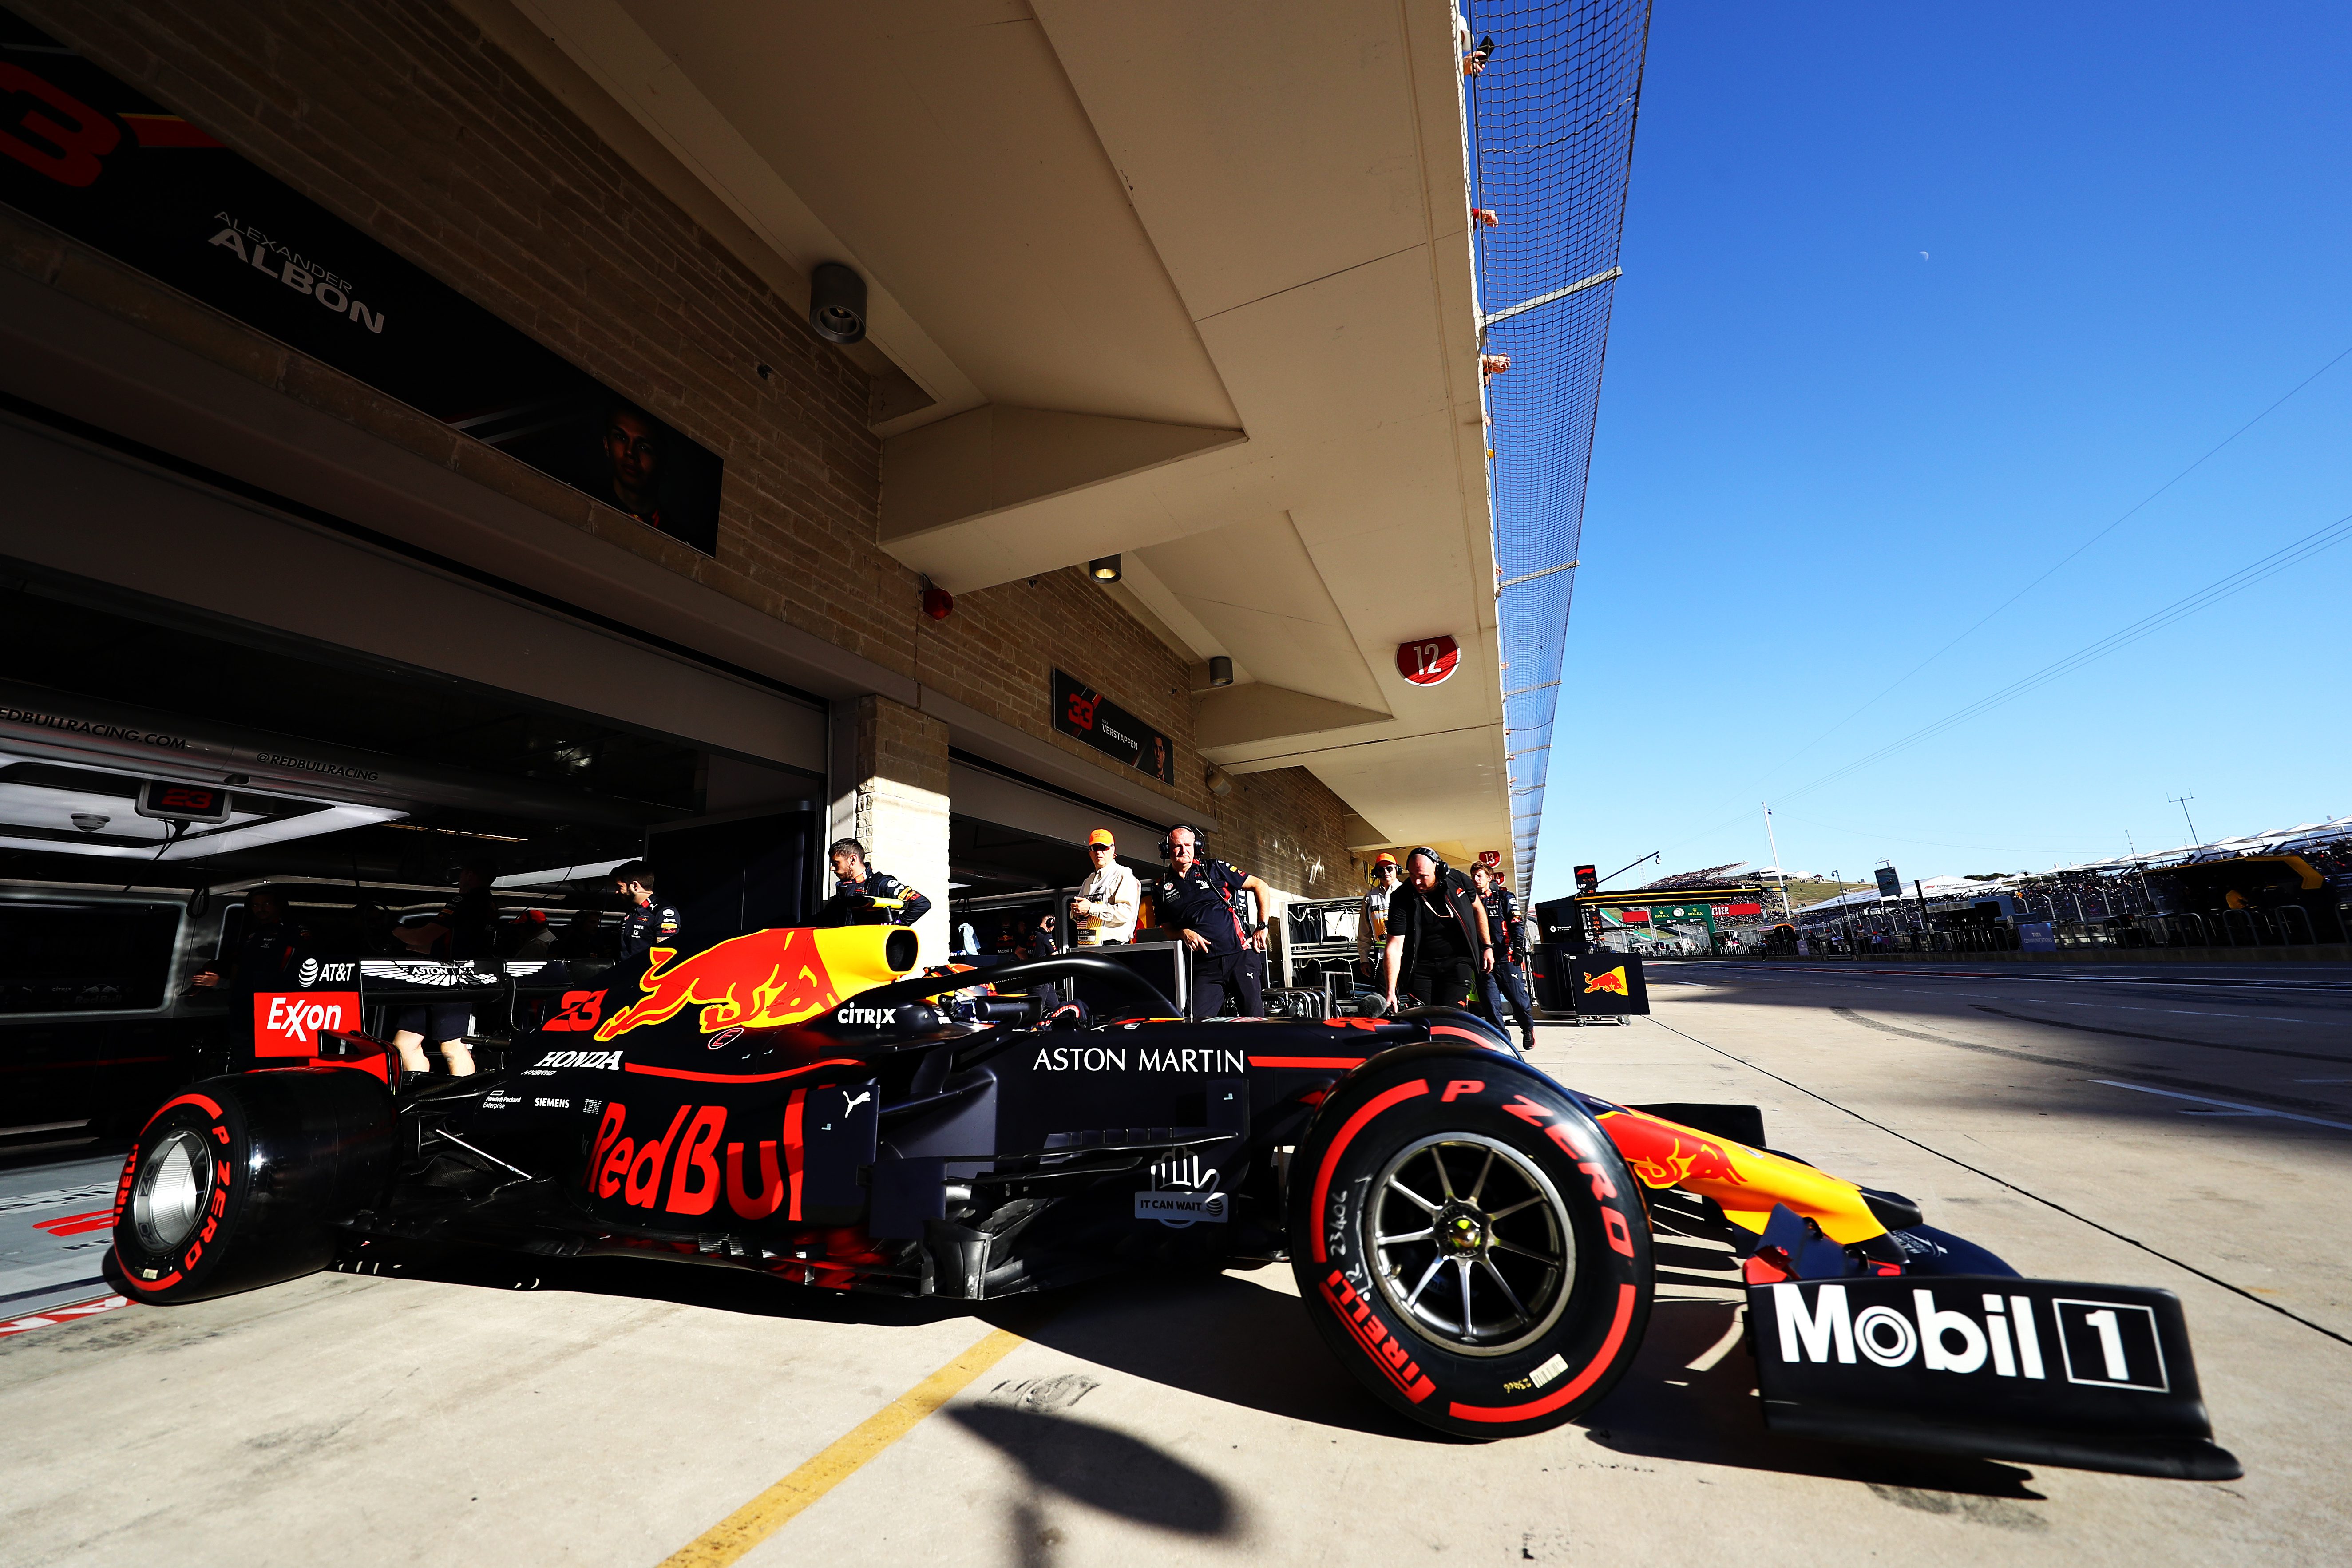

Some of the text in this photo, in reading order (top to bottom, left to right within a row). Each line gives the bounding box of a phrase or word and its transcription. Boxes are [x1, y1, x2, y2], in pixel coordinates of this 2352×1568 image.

[214, 211, 352, 295] ALEXANDER
[208, 228, 385, 334] ALBON
[1413, 643, 1442, 675] 12
[1068, 693, 1093, 731] 33
[1101, 723, 1138, 750] VERSTAPPEN
[257, 752, 378, 781] @REDBULLRACING
[162, 788, 213, 809] 23
[1485, 853, 1495, 865] 13
[319, 963, 355, 982] AT&T
[267, 997, 341, 1042] Exxon
[542, 988, 609, 1032] 23
[533, 1050, 624, 1071] HONDA
[1033, 1048, 1243, 1073] ASTON MARTIN
[482, 1101, 505, 1109] Enterprise
[534, 1097, 570, 1108] SIEMENS
[582, 1099, 602, 1114] IBM
[113, 1144, 139, 1227] PIRELLI
[1502, 1094, 1635, 1258] ZERO
[185, 1160, 230, 1271] ZERO
[1140, 1200, 1202, 1212] IT CAN WAIT
[1329, 1190, 1348, 1257] 23406
[1319, 1269, 1437, 1404] PIRELLI
[1774, 1283, 2130, 1382] Mobil 1
